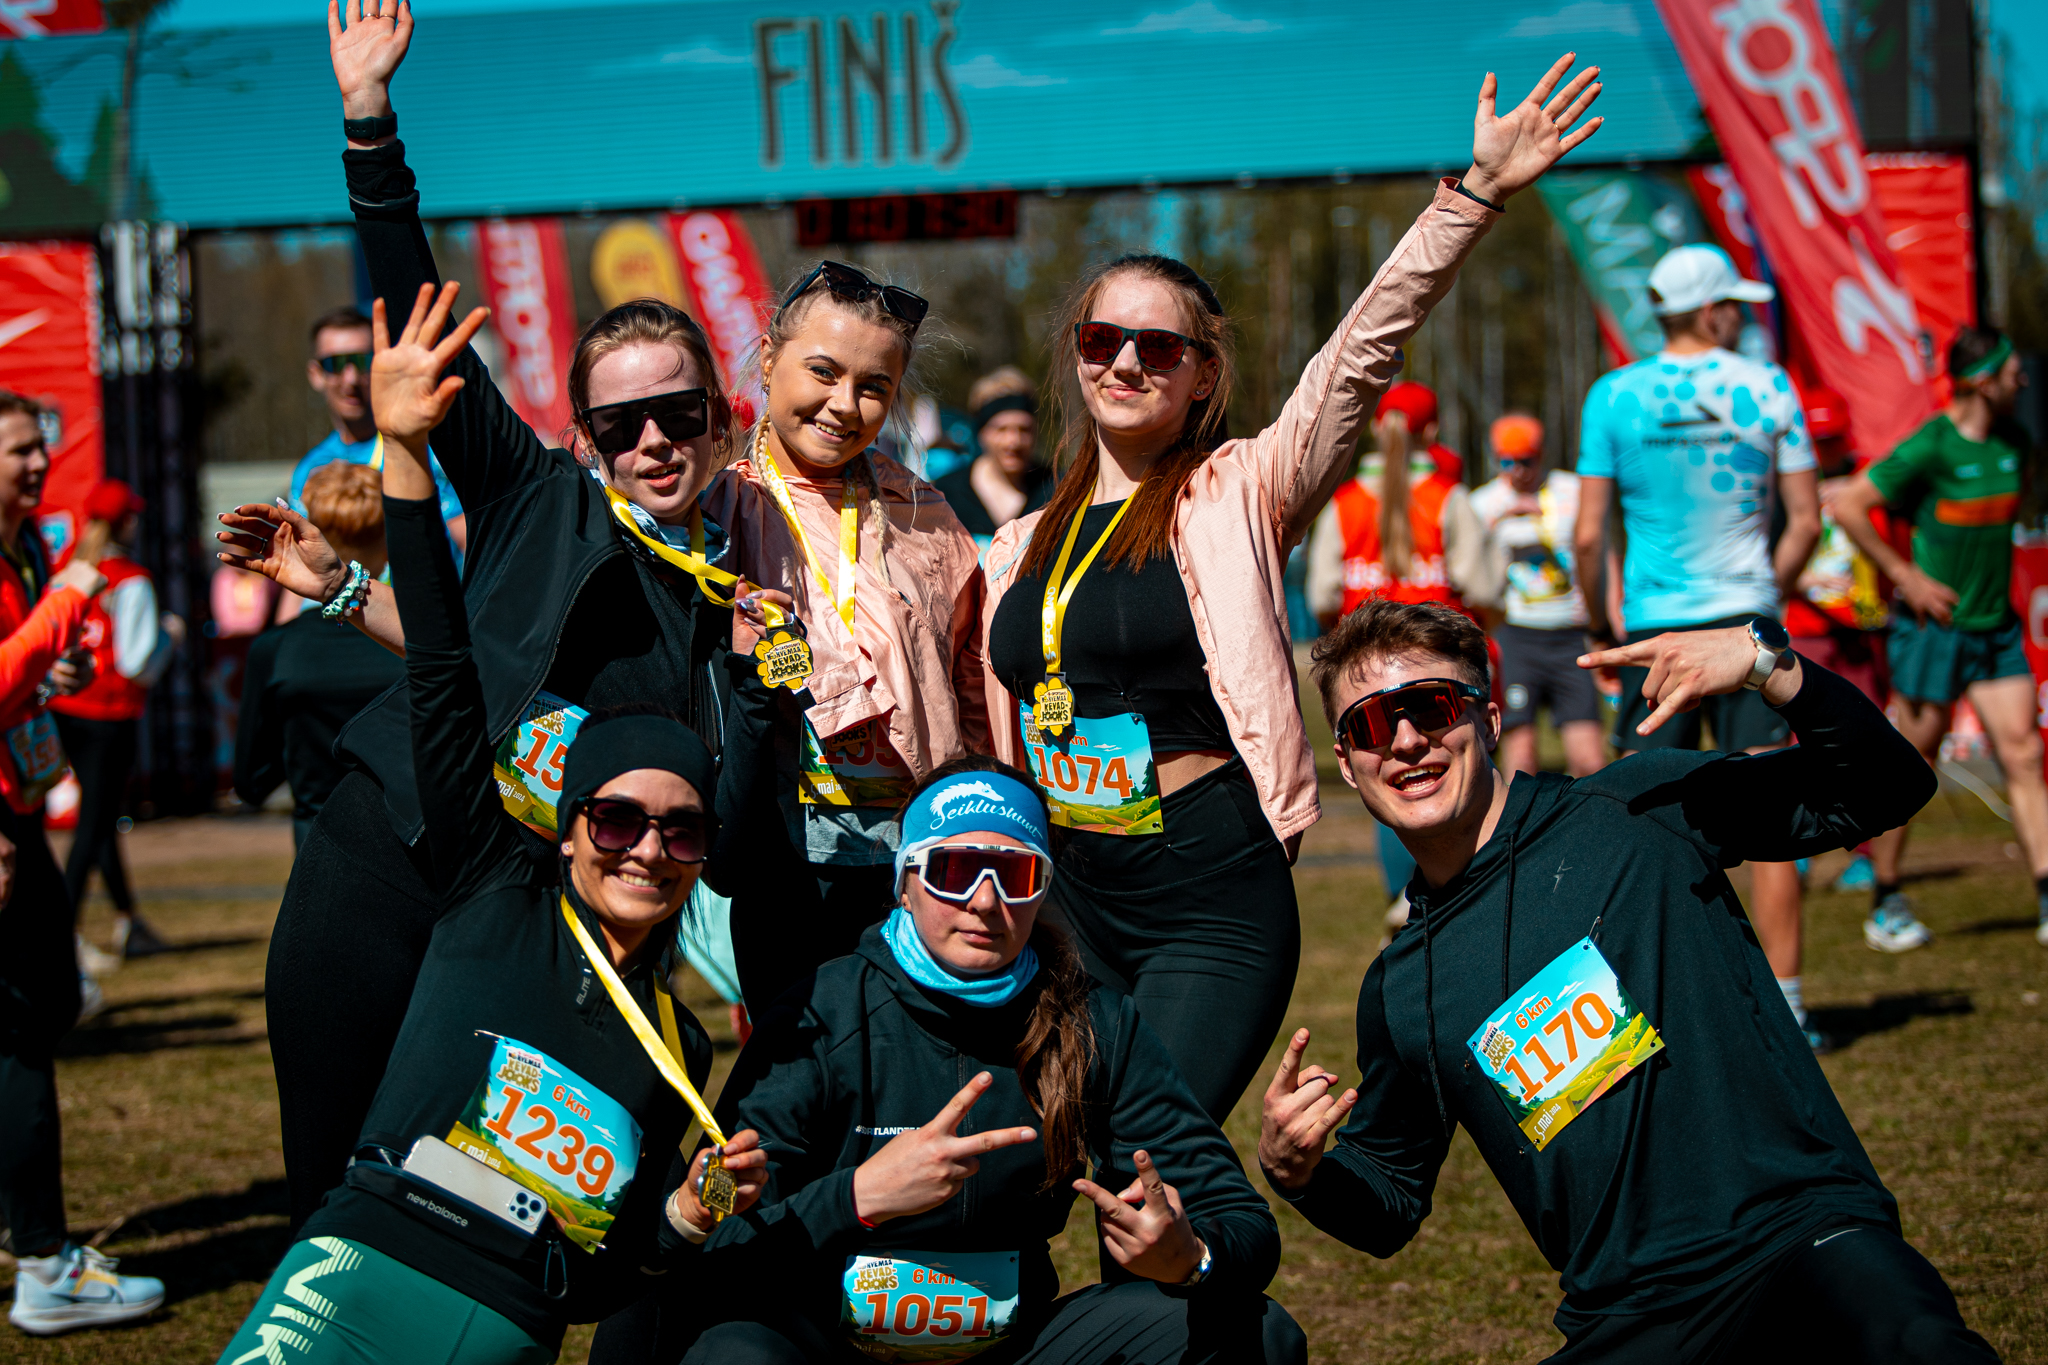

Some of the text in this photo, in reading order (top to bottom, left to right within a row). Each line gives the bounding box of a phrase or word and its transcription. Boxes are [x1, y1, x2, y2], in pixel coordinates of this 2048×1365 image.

[757, 2, 970, 168] FINIŠ
[1045, 586, 1056, 645] SPORTLAND
[1066, 731, 1088, 746] km
[514, 727, 577, 791] 15
[1033, 746, 1134, 798] 1074
[930, 800, 1044, 839] Seiklushunt
[576, 976, 591, 1005] ELITE
[1515, 996, 1552, 1029] 6 km
[1504, 992, 1616, 1103] 1170
[552, 1085, 592, 1121] 6 km
[1549, 1103, 1562, 1117] 2024
[485, 1086, 615, 1196] 1239
[406, 1192, 469, 1227] new balance
[854, 1275, 898, 1292] JOOKS
[860, 1267, 896, 1279] KEVAD-
[912, 1269, 956, 1285] 6 km
[862, 1293, 992, 1337] 1051
